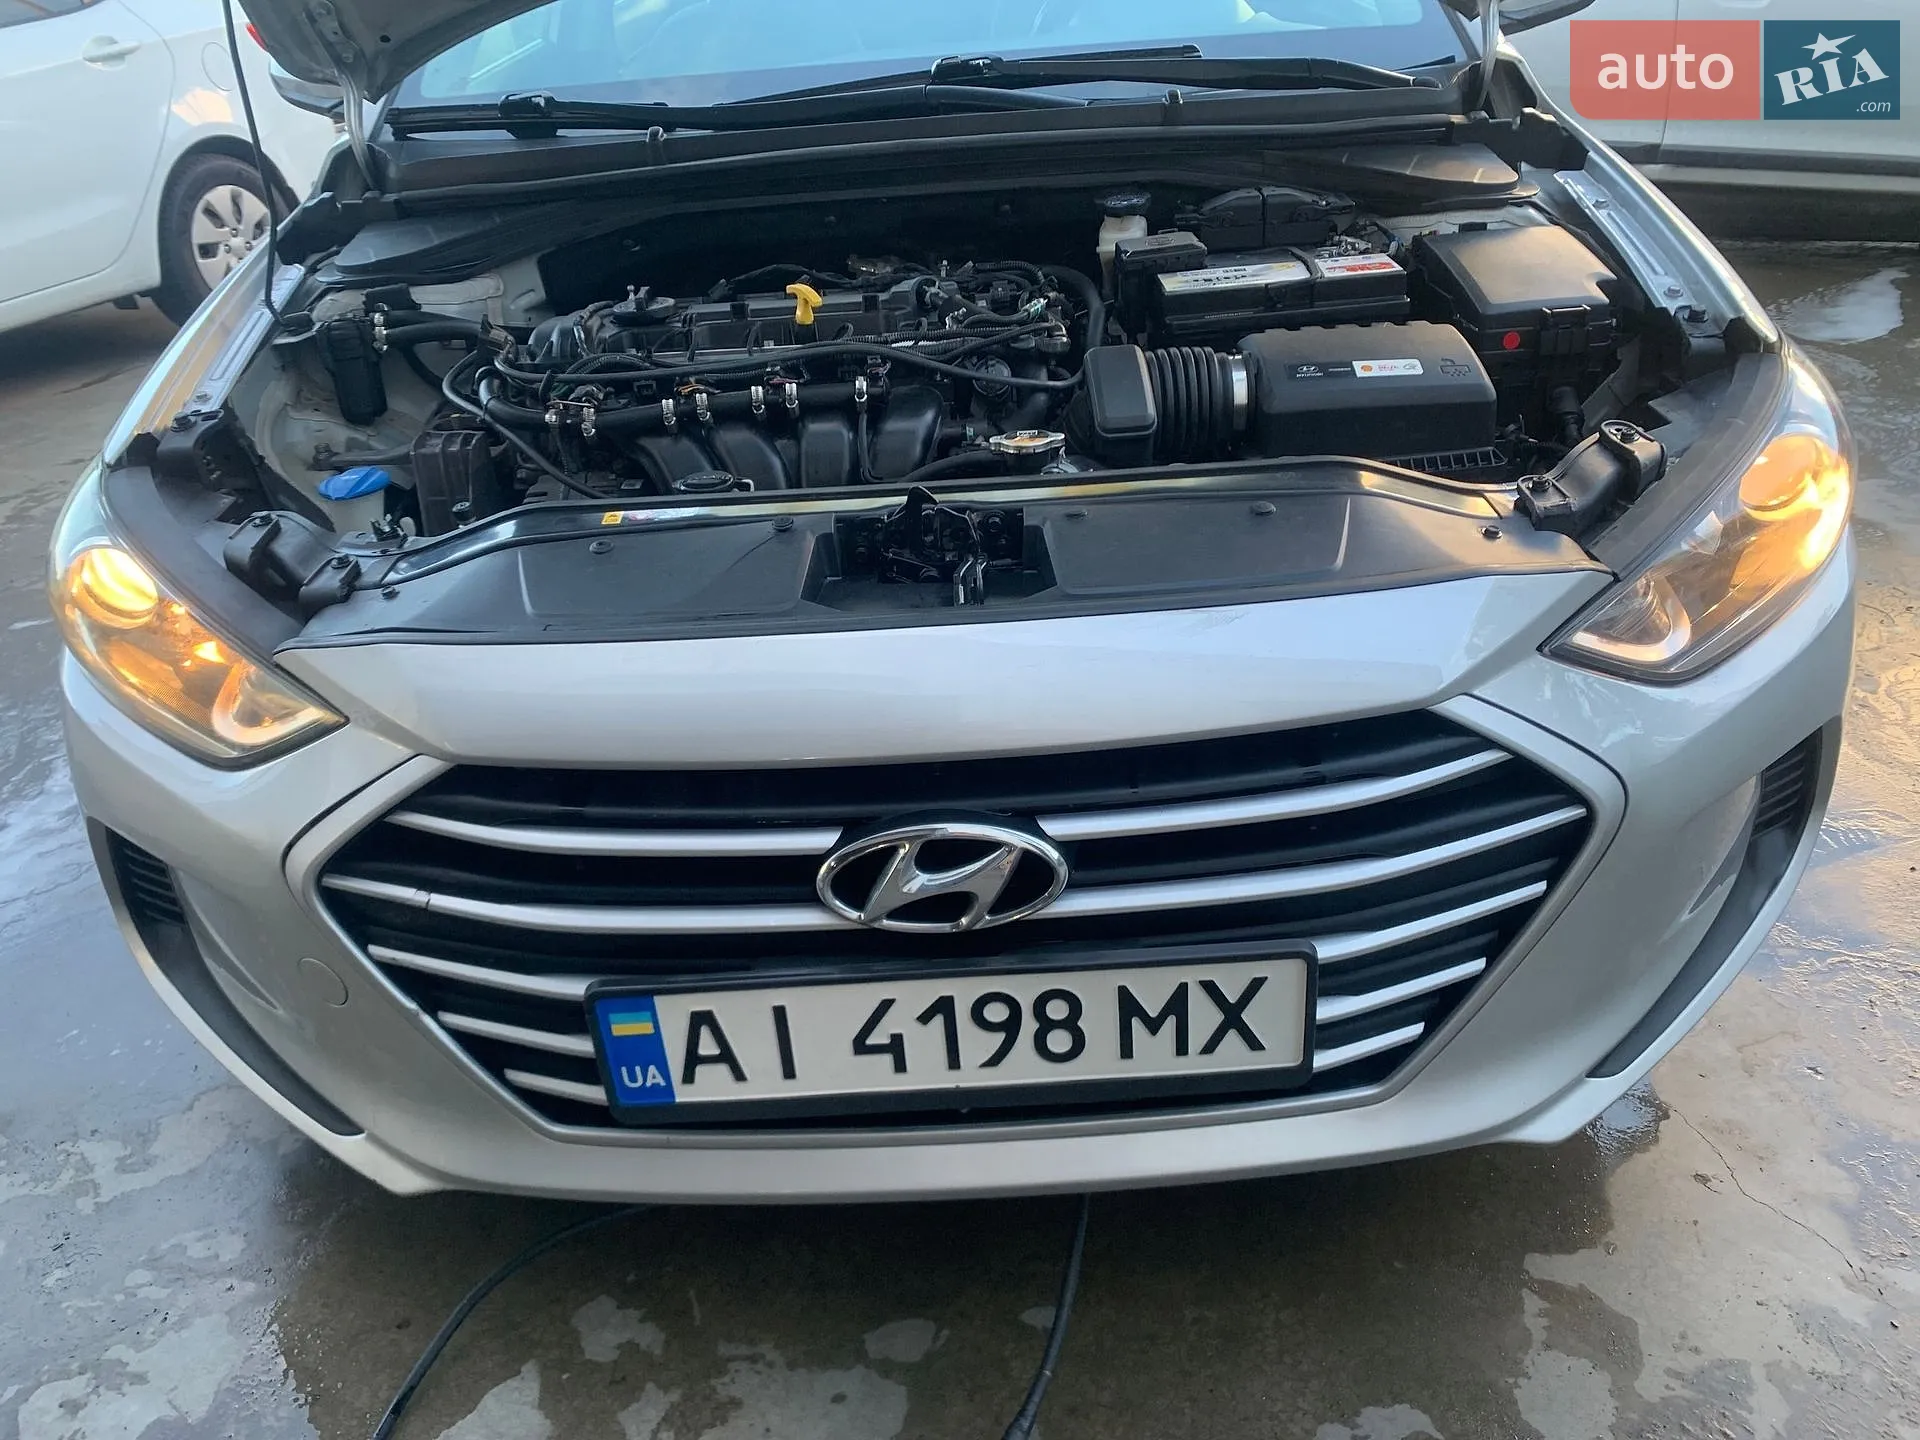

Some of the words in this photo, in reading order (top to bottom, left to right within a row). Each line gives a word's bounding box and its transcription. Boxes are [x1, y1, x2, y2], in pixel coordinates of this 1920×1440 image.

[682, 1005, 796, 1085] AI
[853, 989, 1087, 1073] 4198
[1118, 976, 1269, 1060] MX
[622, 1065, 667, 1089] UA
